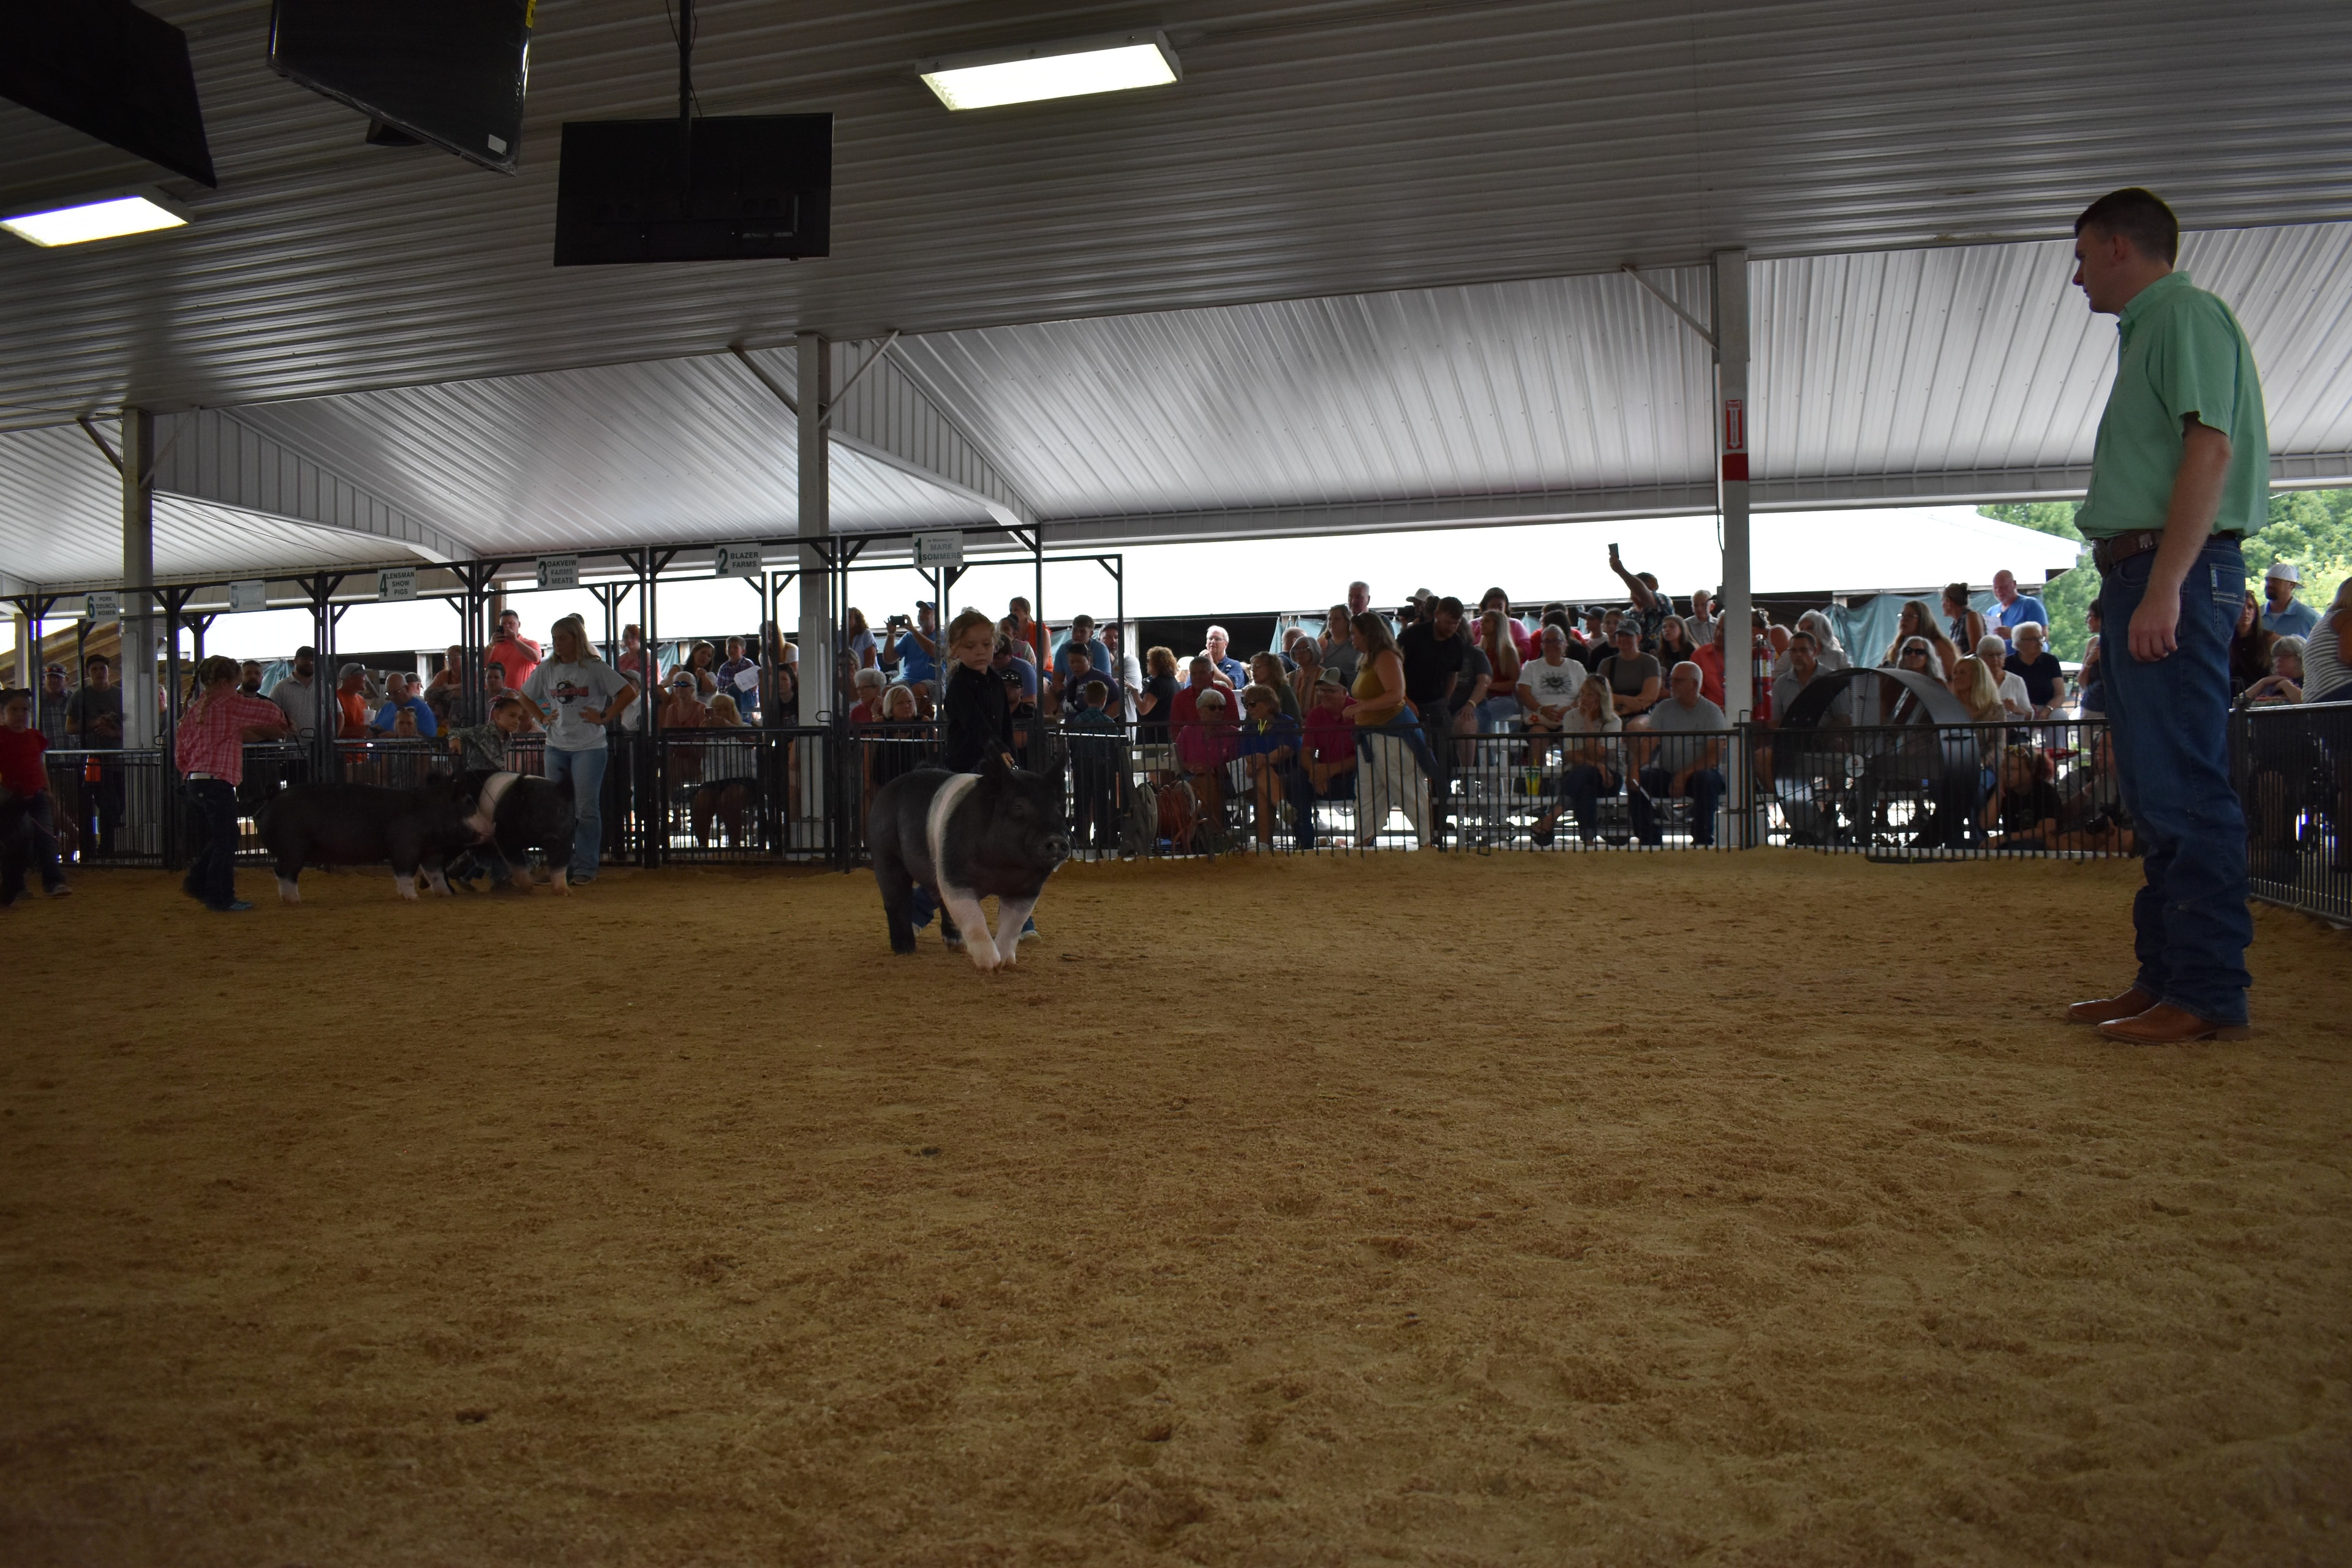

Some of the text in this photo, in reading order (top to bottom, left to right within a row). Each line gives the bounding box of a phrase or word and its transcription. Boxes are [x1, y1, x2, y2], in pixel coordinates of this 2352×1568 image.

[718, 548, 728, 574] 2
[914, 538, 922, 564] 1
[922, 552, 961, 560] SOMMERS
[379, 573, 388, 597] 4
[538, 561, 548, 586] 3
[88, 595, 94, 619] 6
[231, 585, 239, 608] 5
